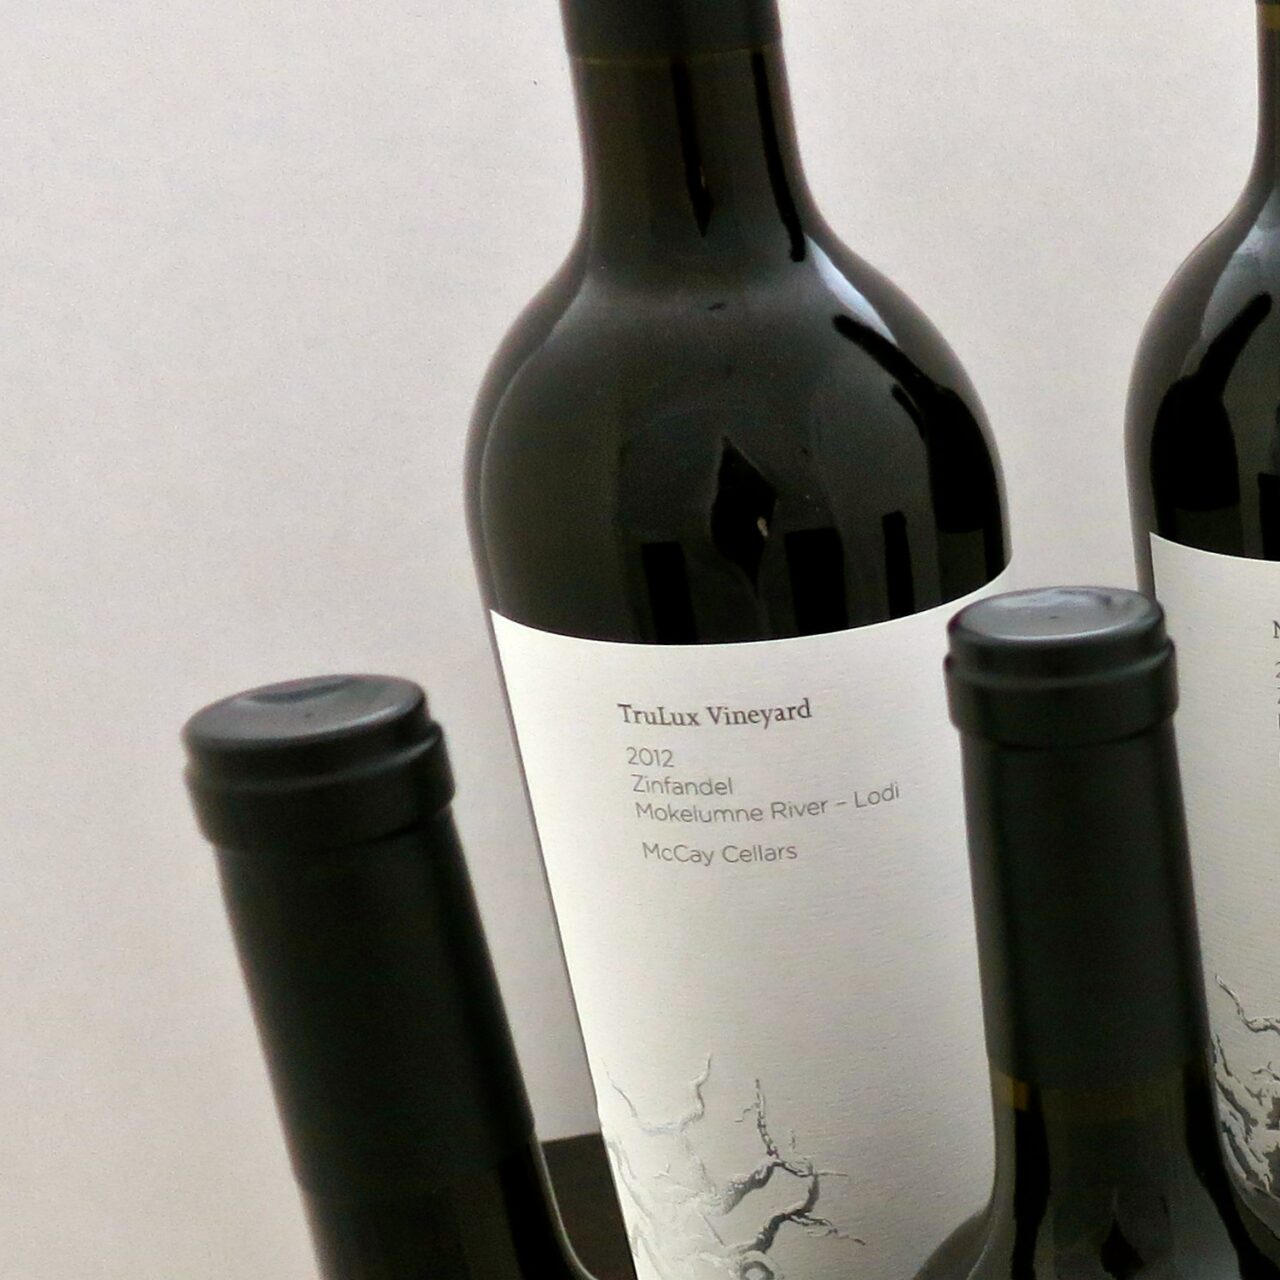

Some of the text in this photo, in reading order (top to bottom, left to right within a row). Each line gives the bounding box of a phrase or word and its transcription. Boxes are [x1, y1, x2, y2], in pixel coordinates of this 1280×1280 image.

[617, 698, 812, 729] TruLux Vineyard
[626, 747, 674, 768] 2012
[631, 774, 733, 796] Zinfandel
[636, 802, 763, 823] Mokelumne
[771, 800, 827, 820] River
[854, 781, 900, 809] Lodi
[642, 842, 797, 867] McCay Cellars
